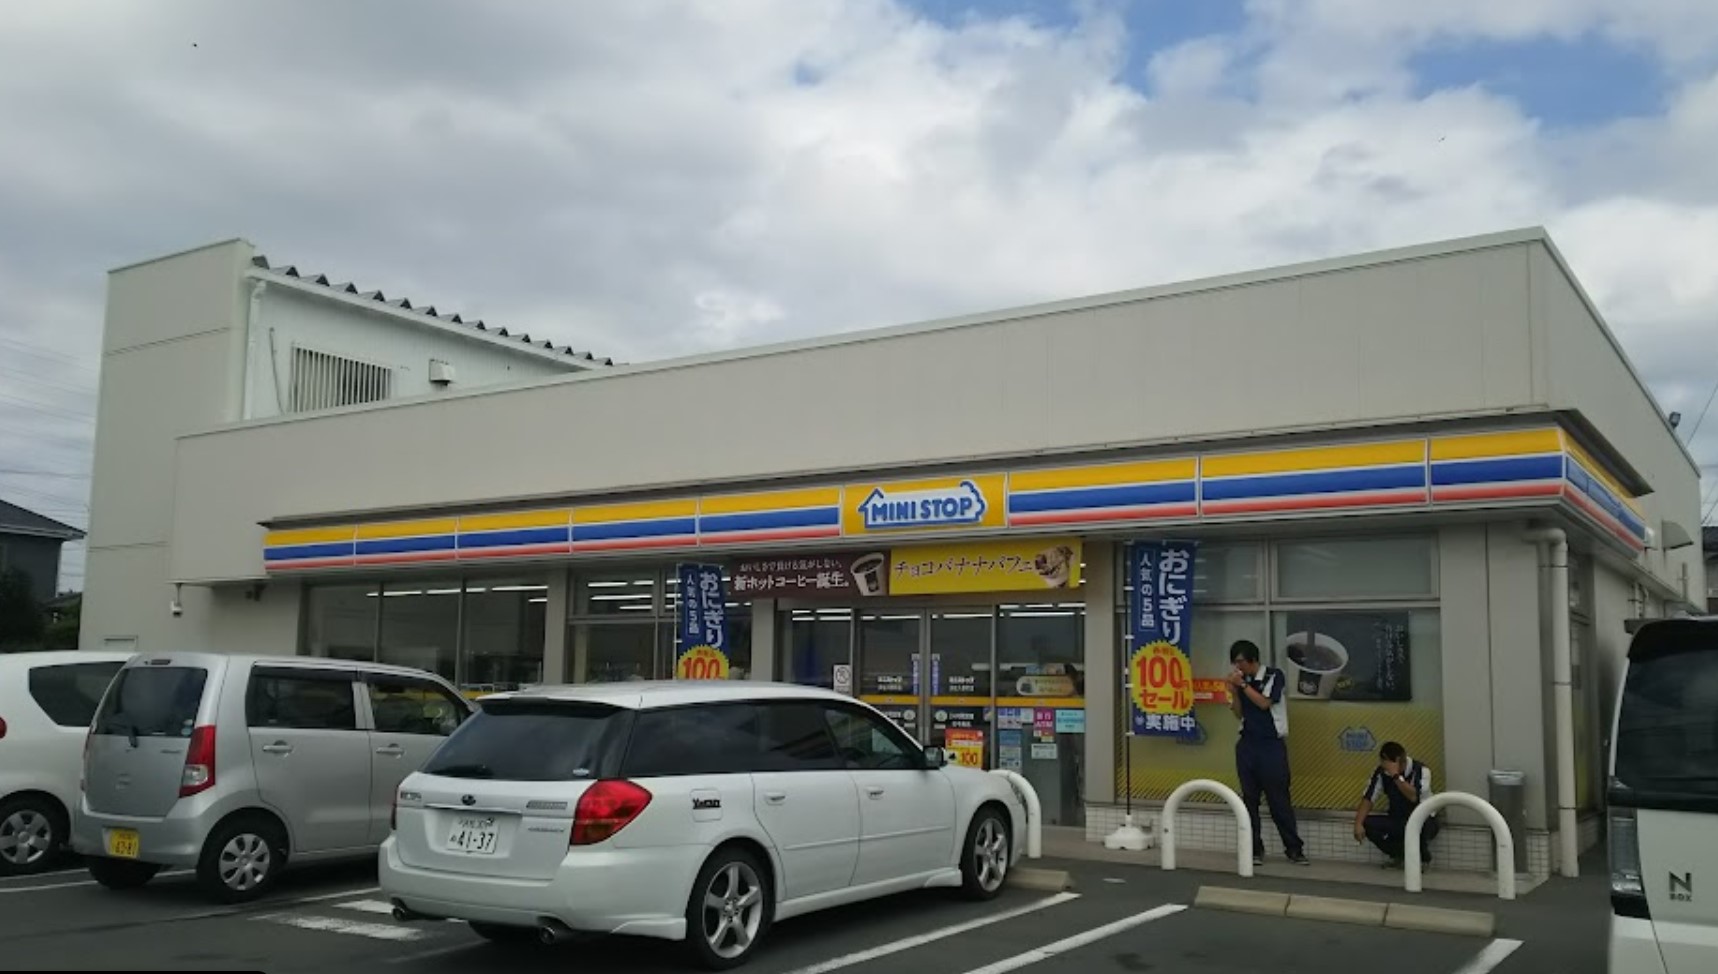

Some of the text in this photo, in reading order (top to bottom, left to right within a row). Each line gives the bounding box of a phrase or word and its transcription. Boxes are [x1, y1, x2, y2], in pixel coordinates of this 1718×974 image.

[872, 497, 972, 522] MINI STOP
[1159, 549, 1189, 645] おにぎり
[700, 571, 723, 648] おにぎり
[683, 657, 727, 679] 100
[1139, 689, 1190, 710] セール
[1145, 714, 1195, 731] 実施中
[457, 831, 495, 851] 41-37
[1668, 871, 1692, 892] N
